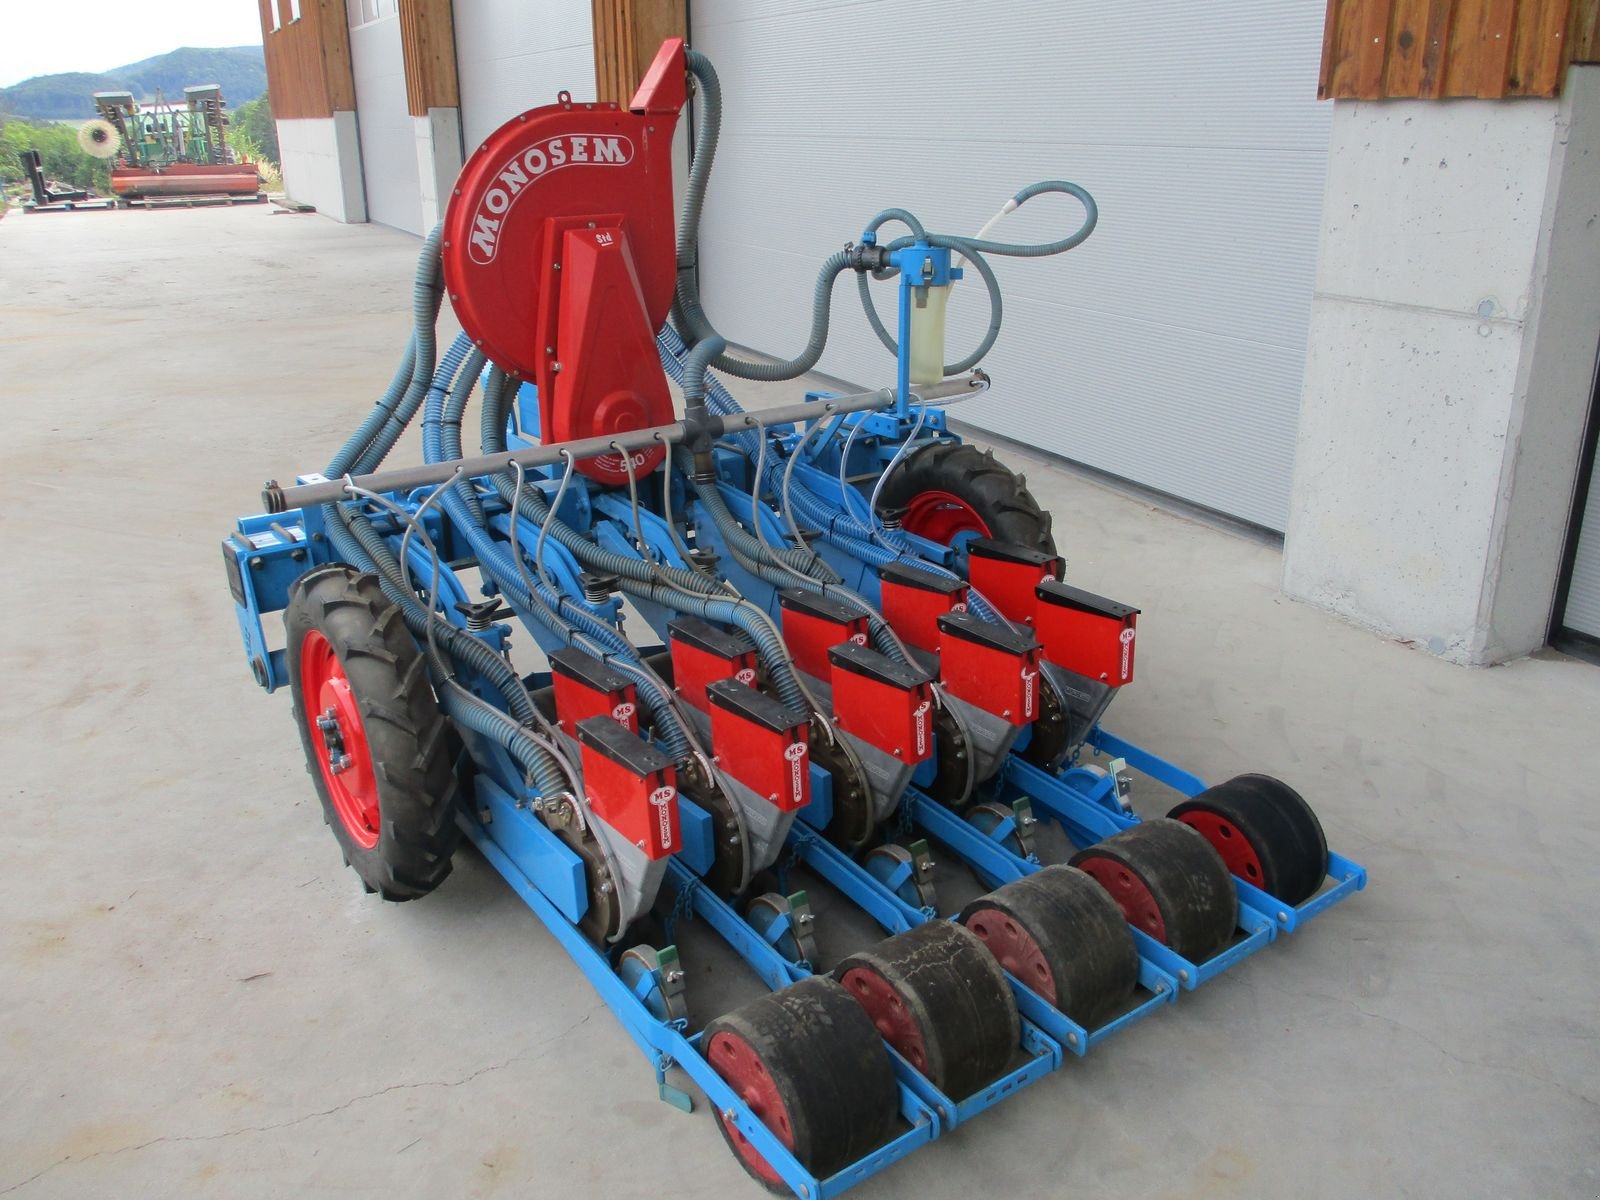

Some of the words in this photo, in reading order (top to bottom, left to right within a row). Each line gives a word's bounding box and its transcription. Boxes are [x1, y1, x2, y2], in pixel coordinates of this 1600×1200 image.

[472, 137, 626, 257] MONOSEM
[595, 231, 613, 244] Std
[1121, 630, 1133, 640] MS
[738, 671, 752, 681] MS
[616, 705, 631, 716] MS
[788, 745, 803, 757] MS
[654, 789, 671, 802] MS
